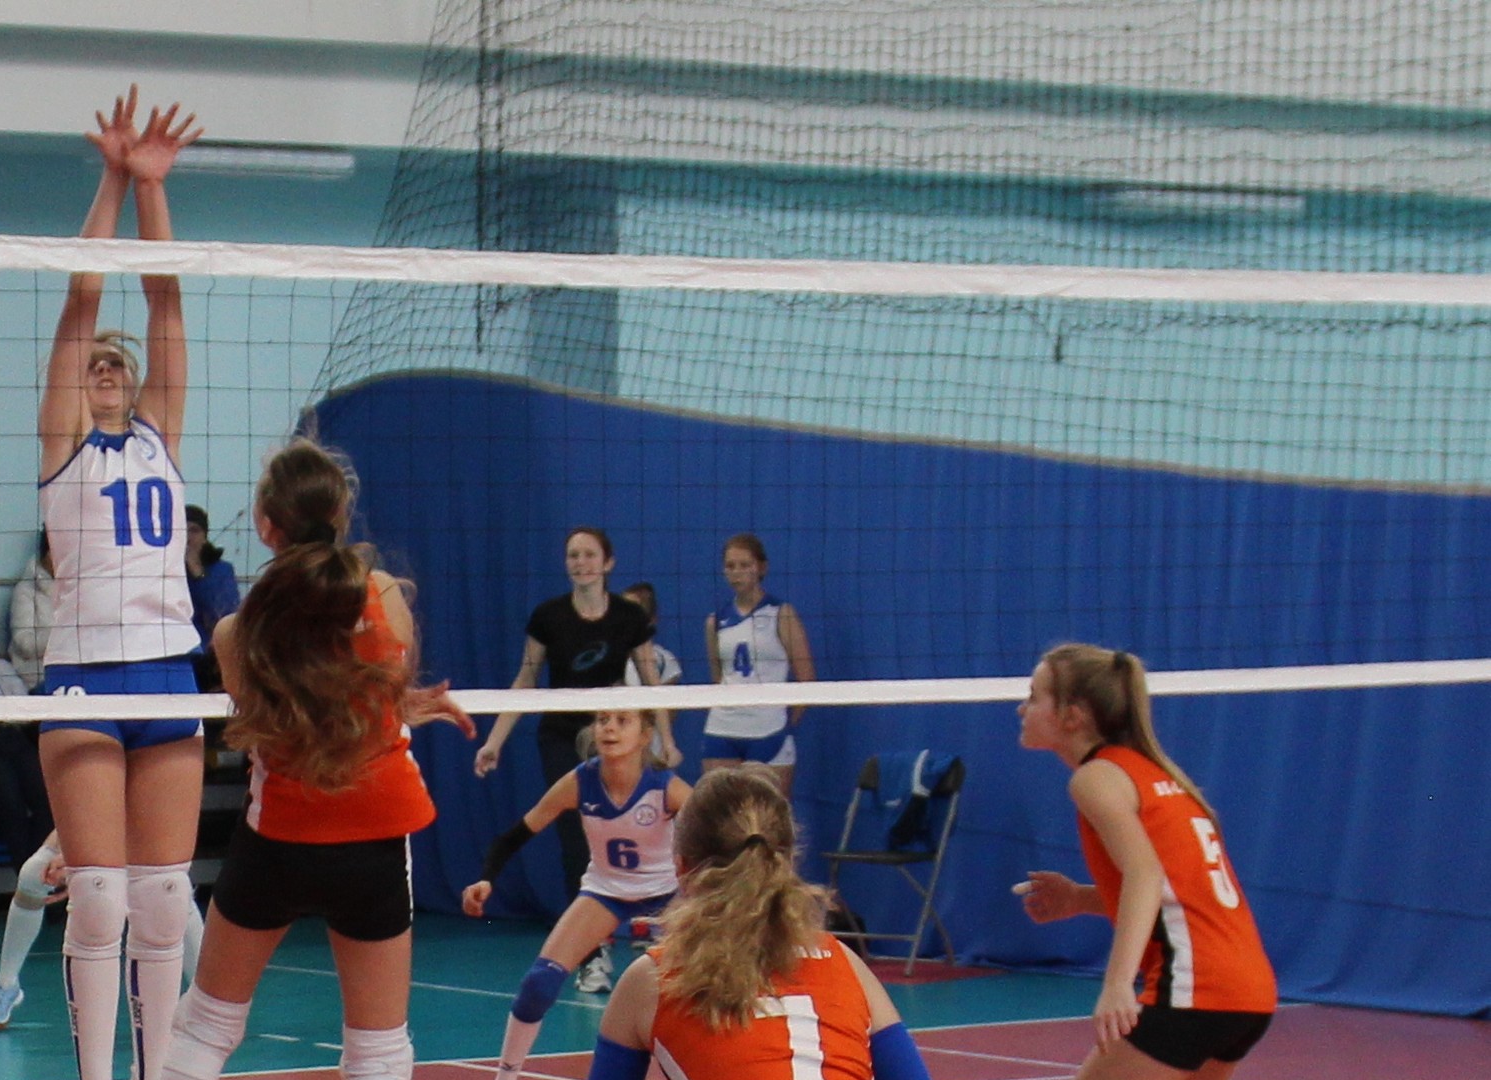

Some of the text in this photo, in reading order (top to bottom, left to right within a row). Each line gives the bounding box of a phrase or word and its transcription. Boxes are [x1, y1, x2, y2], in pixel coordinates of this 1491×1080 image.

[99, 476, 173, 547] 10
[733, 642, 753, 677] 4
[606, 838, 640, 870] 6
[1191, 817, 1240, 909] 5
